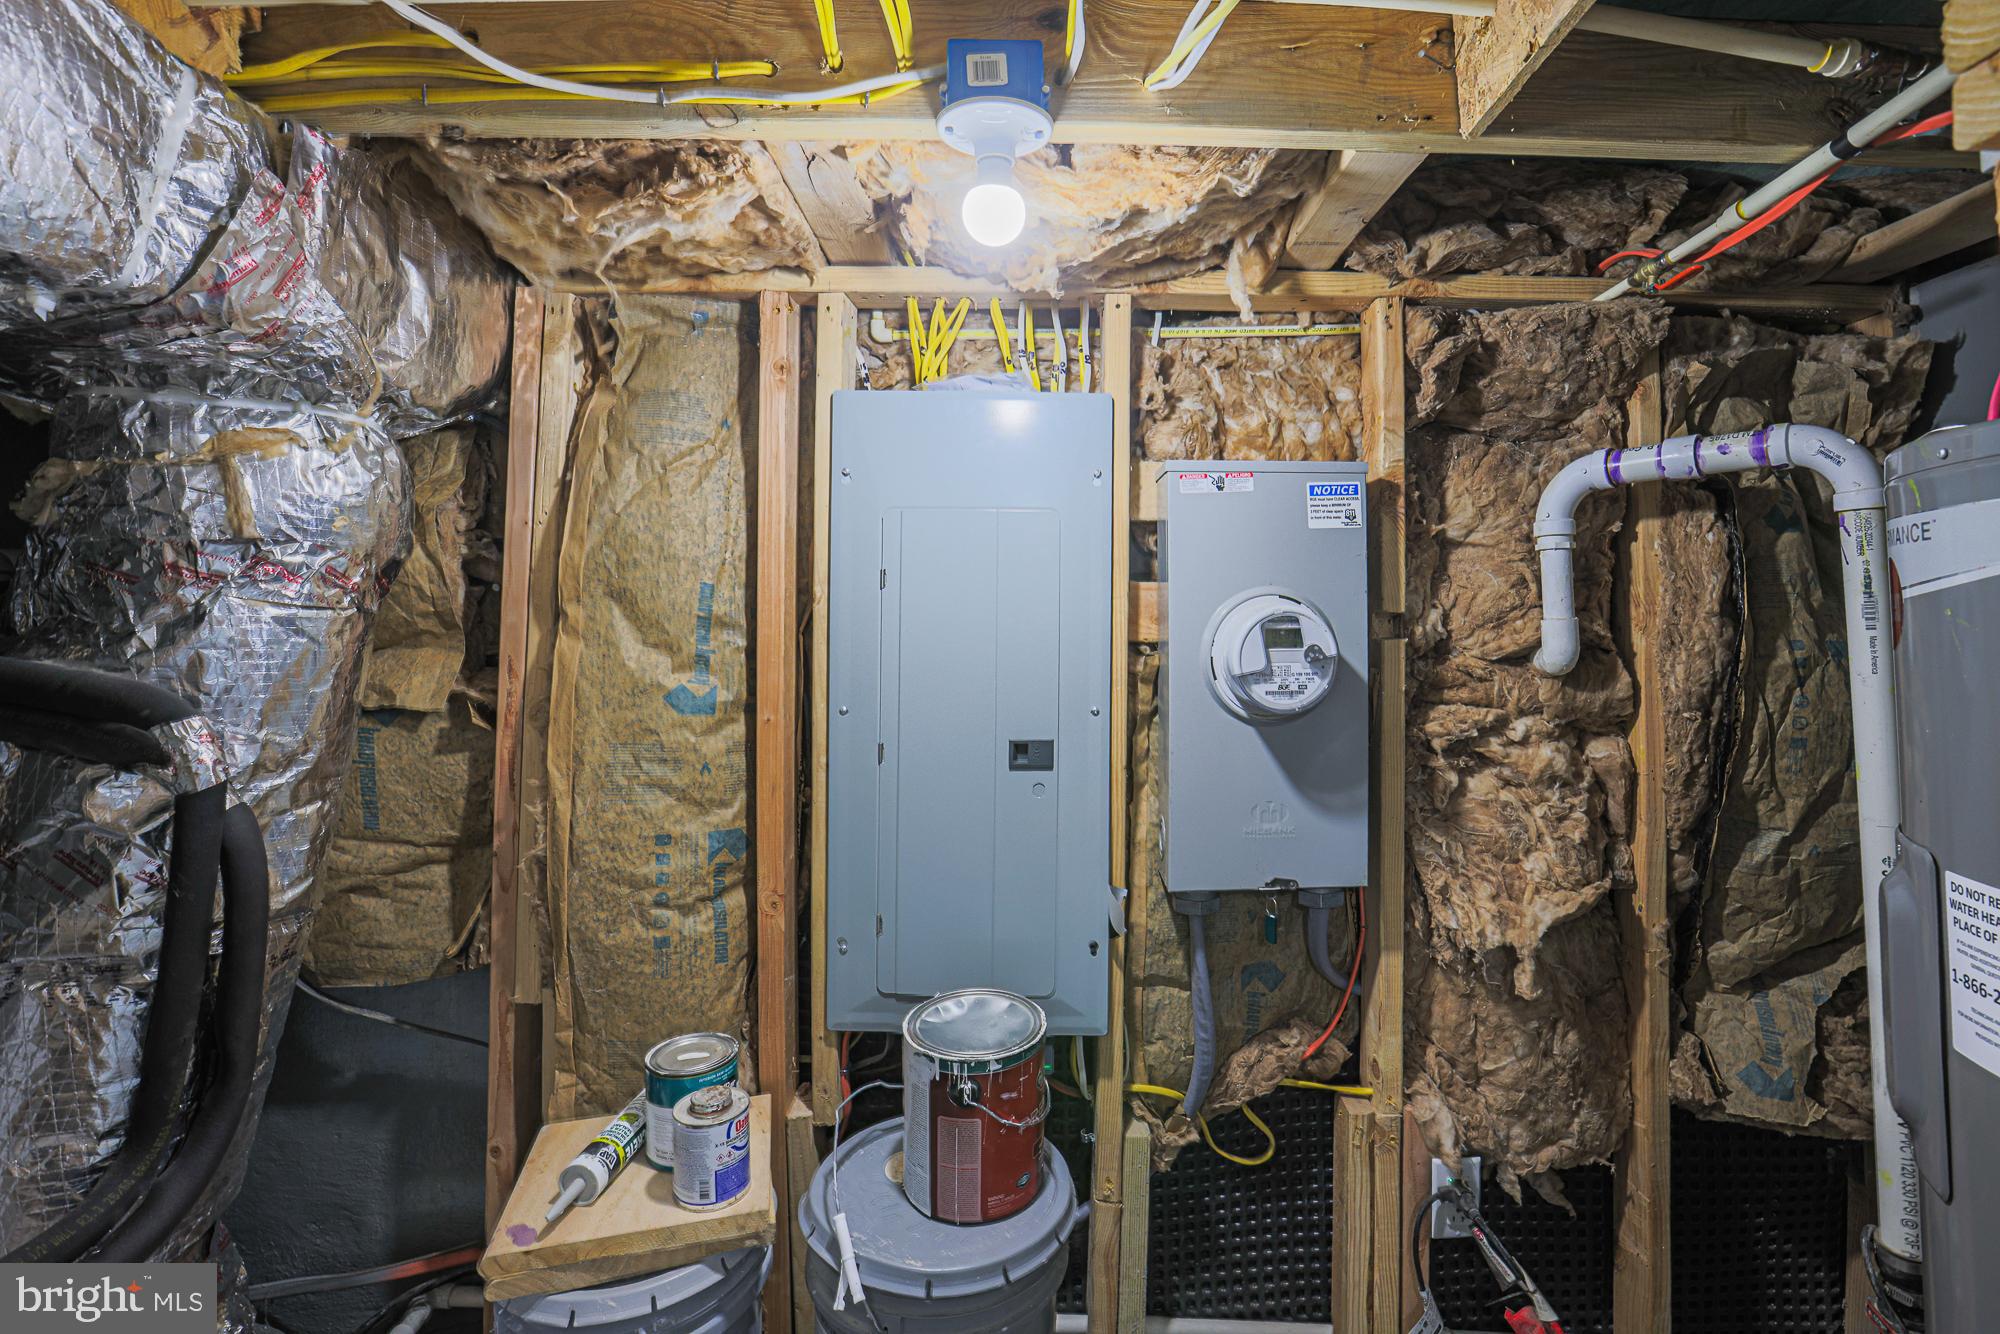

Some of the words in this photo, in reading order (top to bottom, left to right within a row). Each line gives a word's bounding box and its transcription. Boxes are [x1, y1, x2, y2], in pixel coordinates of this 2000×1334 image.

[1314, 486, 1355, 495] NOTICE
[1950, 881, 1963, 895] DO
[1966, 887, 1986, 904] NOT
[1949, 897, 1979, 920] WATER
[1953, 917, 1981, 938] PLACE
[1984, 930, 1998, 944] OF
[1900, 1157, 1916, 1178] 1120
[1902, 1180, 1917, 1199] 330
[1904, 1200, 1917, 1217] PSI
[1900, 1218, 1918, 1230] @
[1904, 1232, 1920, 1250] 73F
